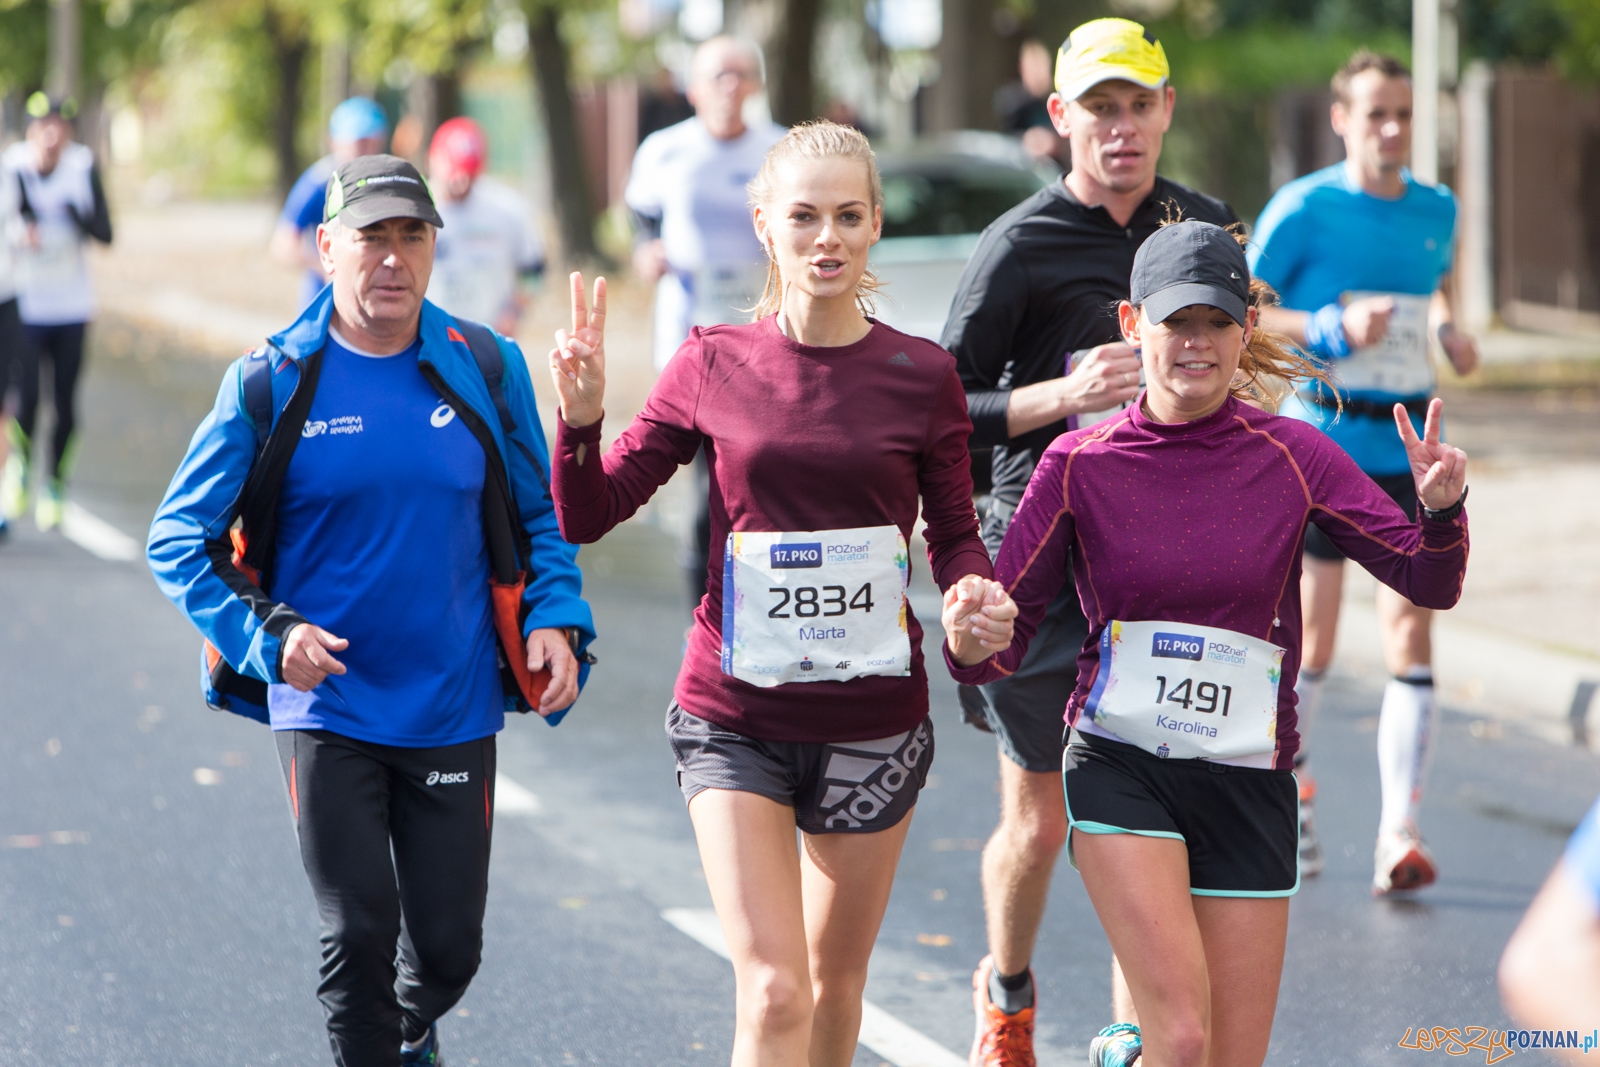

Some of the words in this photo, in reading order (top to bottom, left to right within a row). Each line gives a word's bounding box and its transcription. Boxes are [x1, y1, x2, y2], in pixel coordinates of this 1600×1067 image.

[774, 551, 790, 562] 17.
[792, 550, 818, 561] PKO
[827, 553, 869, 562] maraton
[768, 582, 874, 619] 2834
[799, 627, 846, 641] Marta
[1157, 639, 1172, 651] 17.
[1173, 641, 1200, 654] PKO
[835, 660, 852, 670] 4F
[1207, 651, 1246, 665] maraton
[1155, 675, 1232, 717] 1491
[1156, 715, 1218, 738] Karolina
[440, 771, 469, 783] asics
